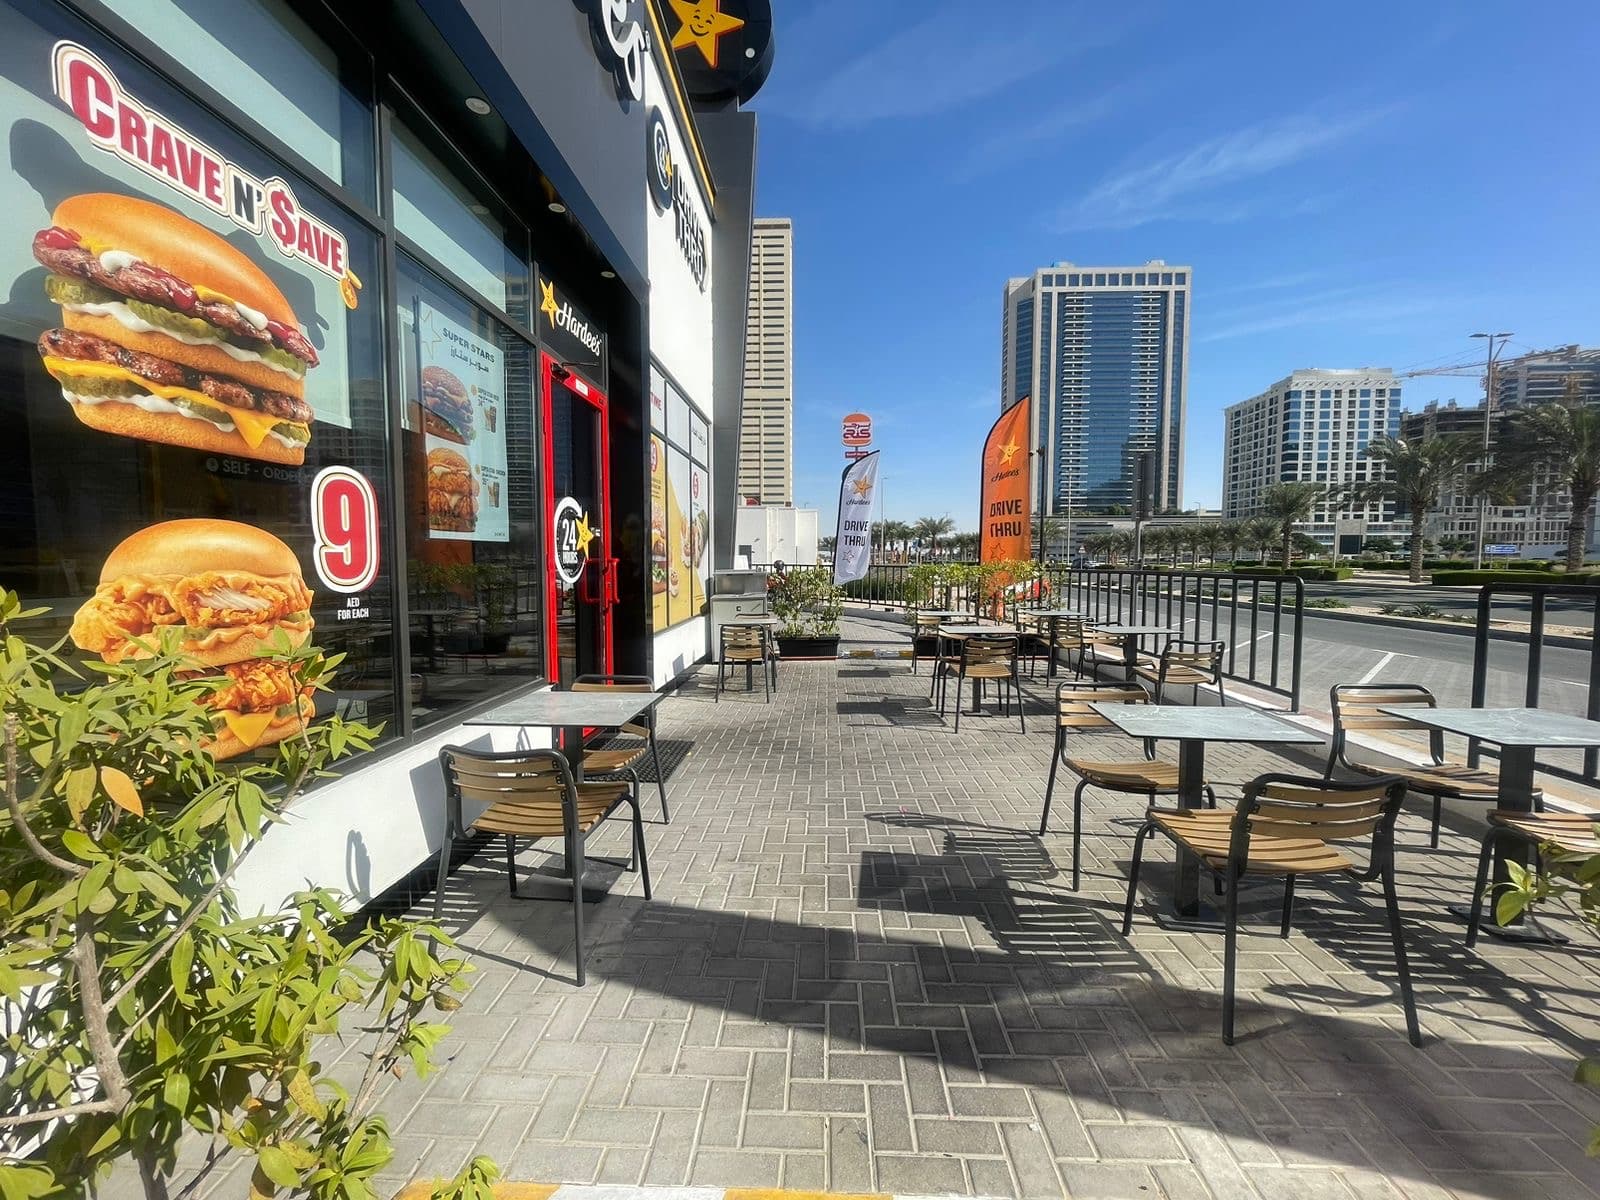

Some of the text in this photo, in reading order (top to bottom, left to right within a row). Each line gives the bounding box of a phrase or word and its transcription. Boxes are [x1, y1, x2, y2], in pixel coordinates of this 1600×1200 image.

[69, 59, 224, 206] CRAVE
[555, 302, 602, 357] Hardee's
[442, 327, 495, 363] SUPER STARS
[222, 459, 250, 475] SELF
[990, 499, 1022, 516] DRIVE
[322, 479, 368, 580] 9
[844, 520, 869, 532] DRIVE
[562, 519, 576, 551] 24
[844, 535, 866, 547] THRU
[347, 597, 360, 608] AED
[337, 608, 369, 620] FOR EACH
